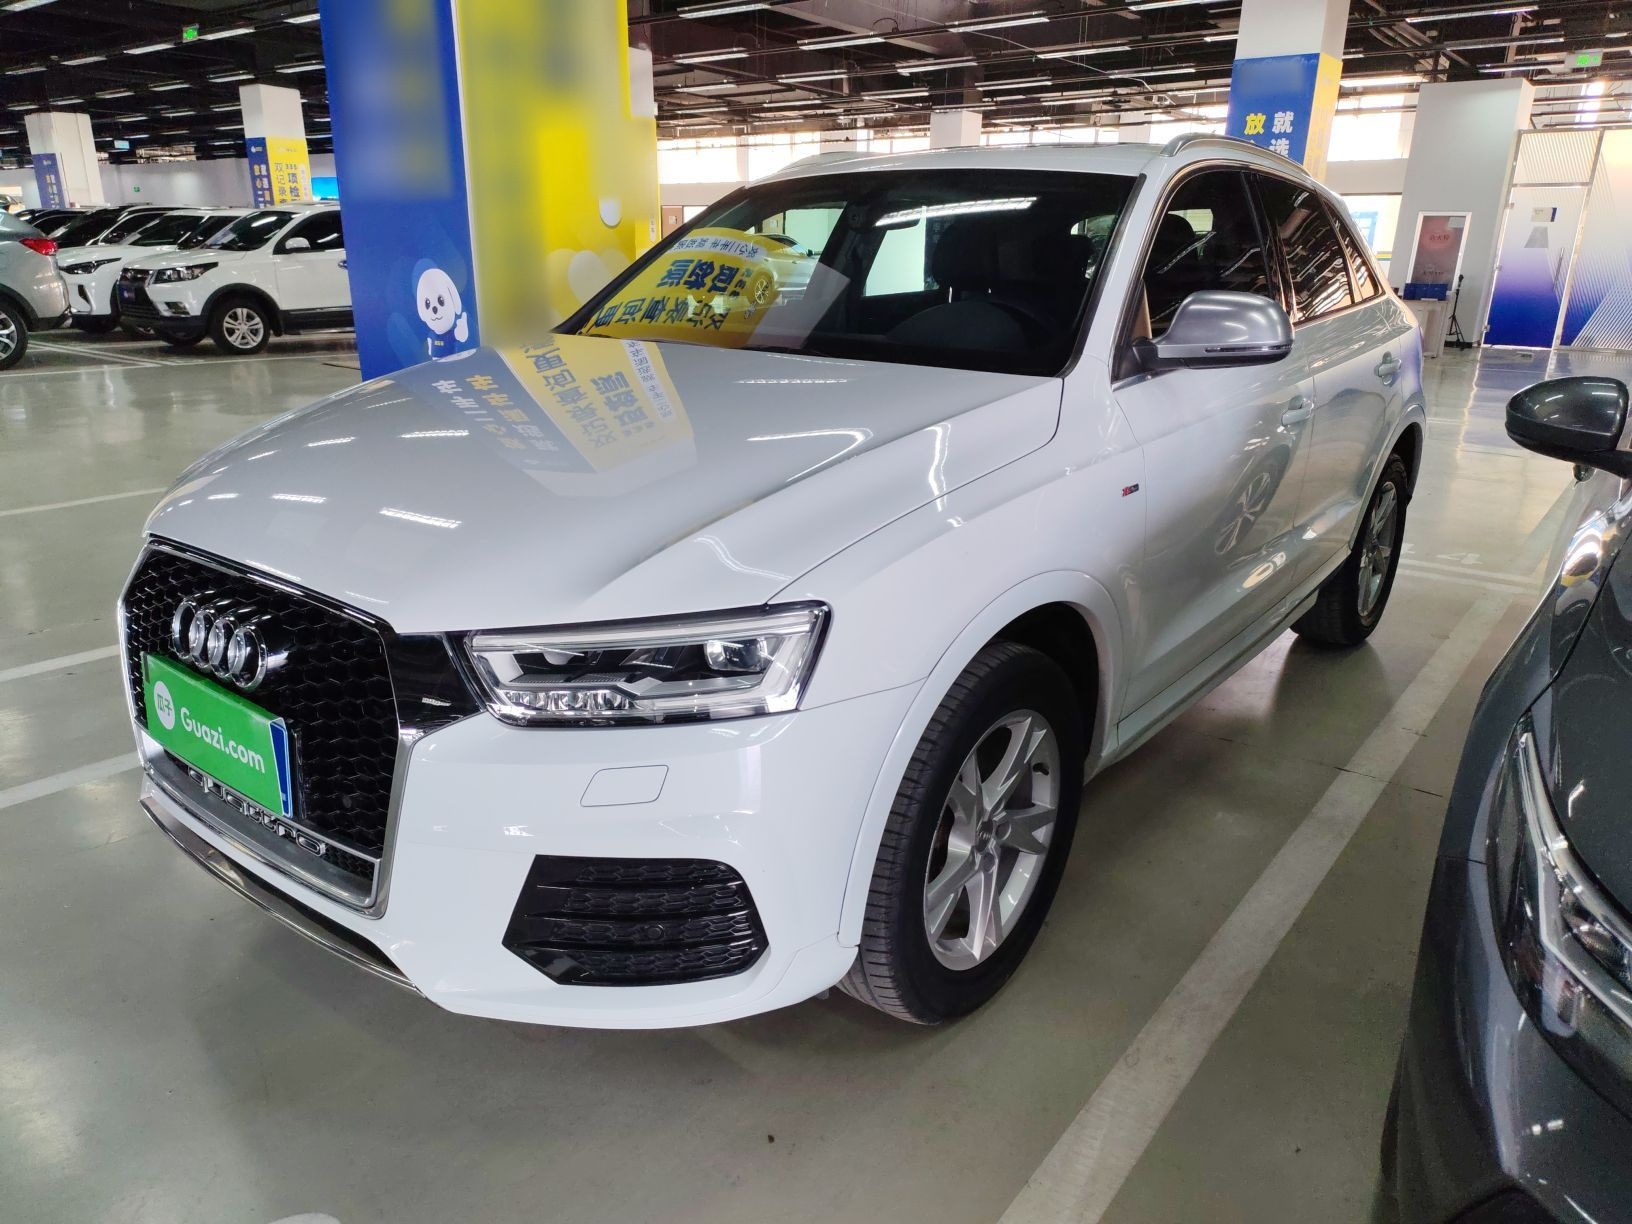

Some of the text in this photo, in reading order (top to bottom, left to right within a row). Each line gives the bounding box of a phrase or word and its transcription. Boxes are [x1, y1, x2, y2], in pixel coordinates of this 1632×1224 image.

[1269, 111, 1294, 157] 就选
[156, 692, 173, 717] 瓜子
[180, 706, 265, 774] Guazi.com
